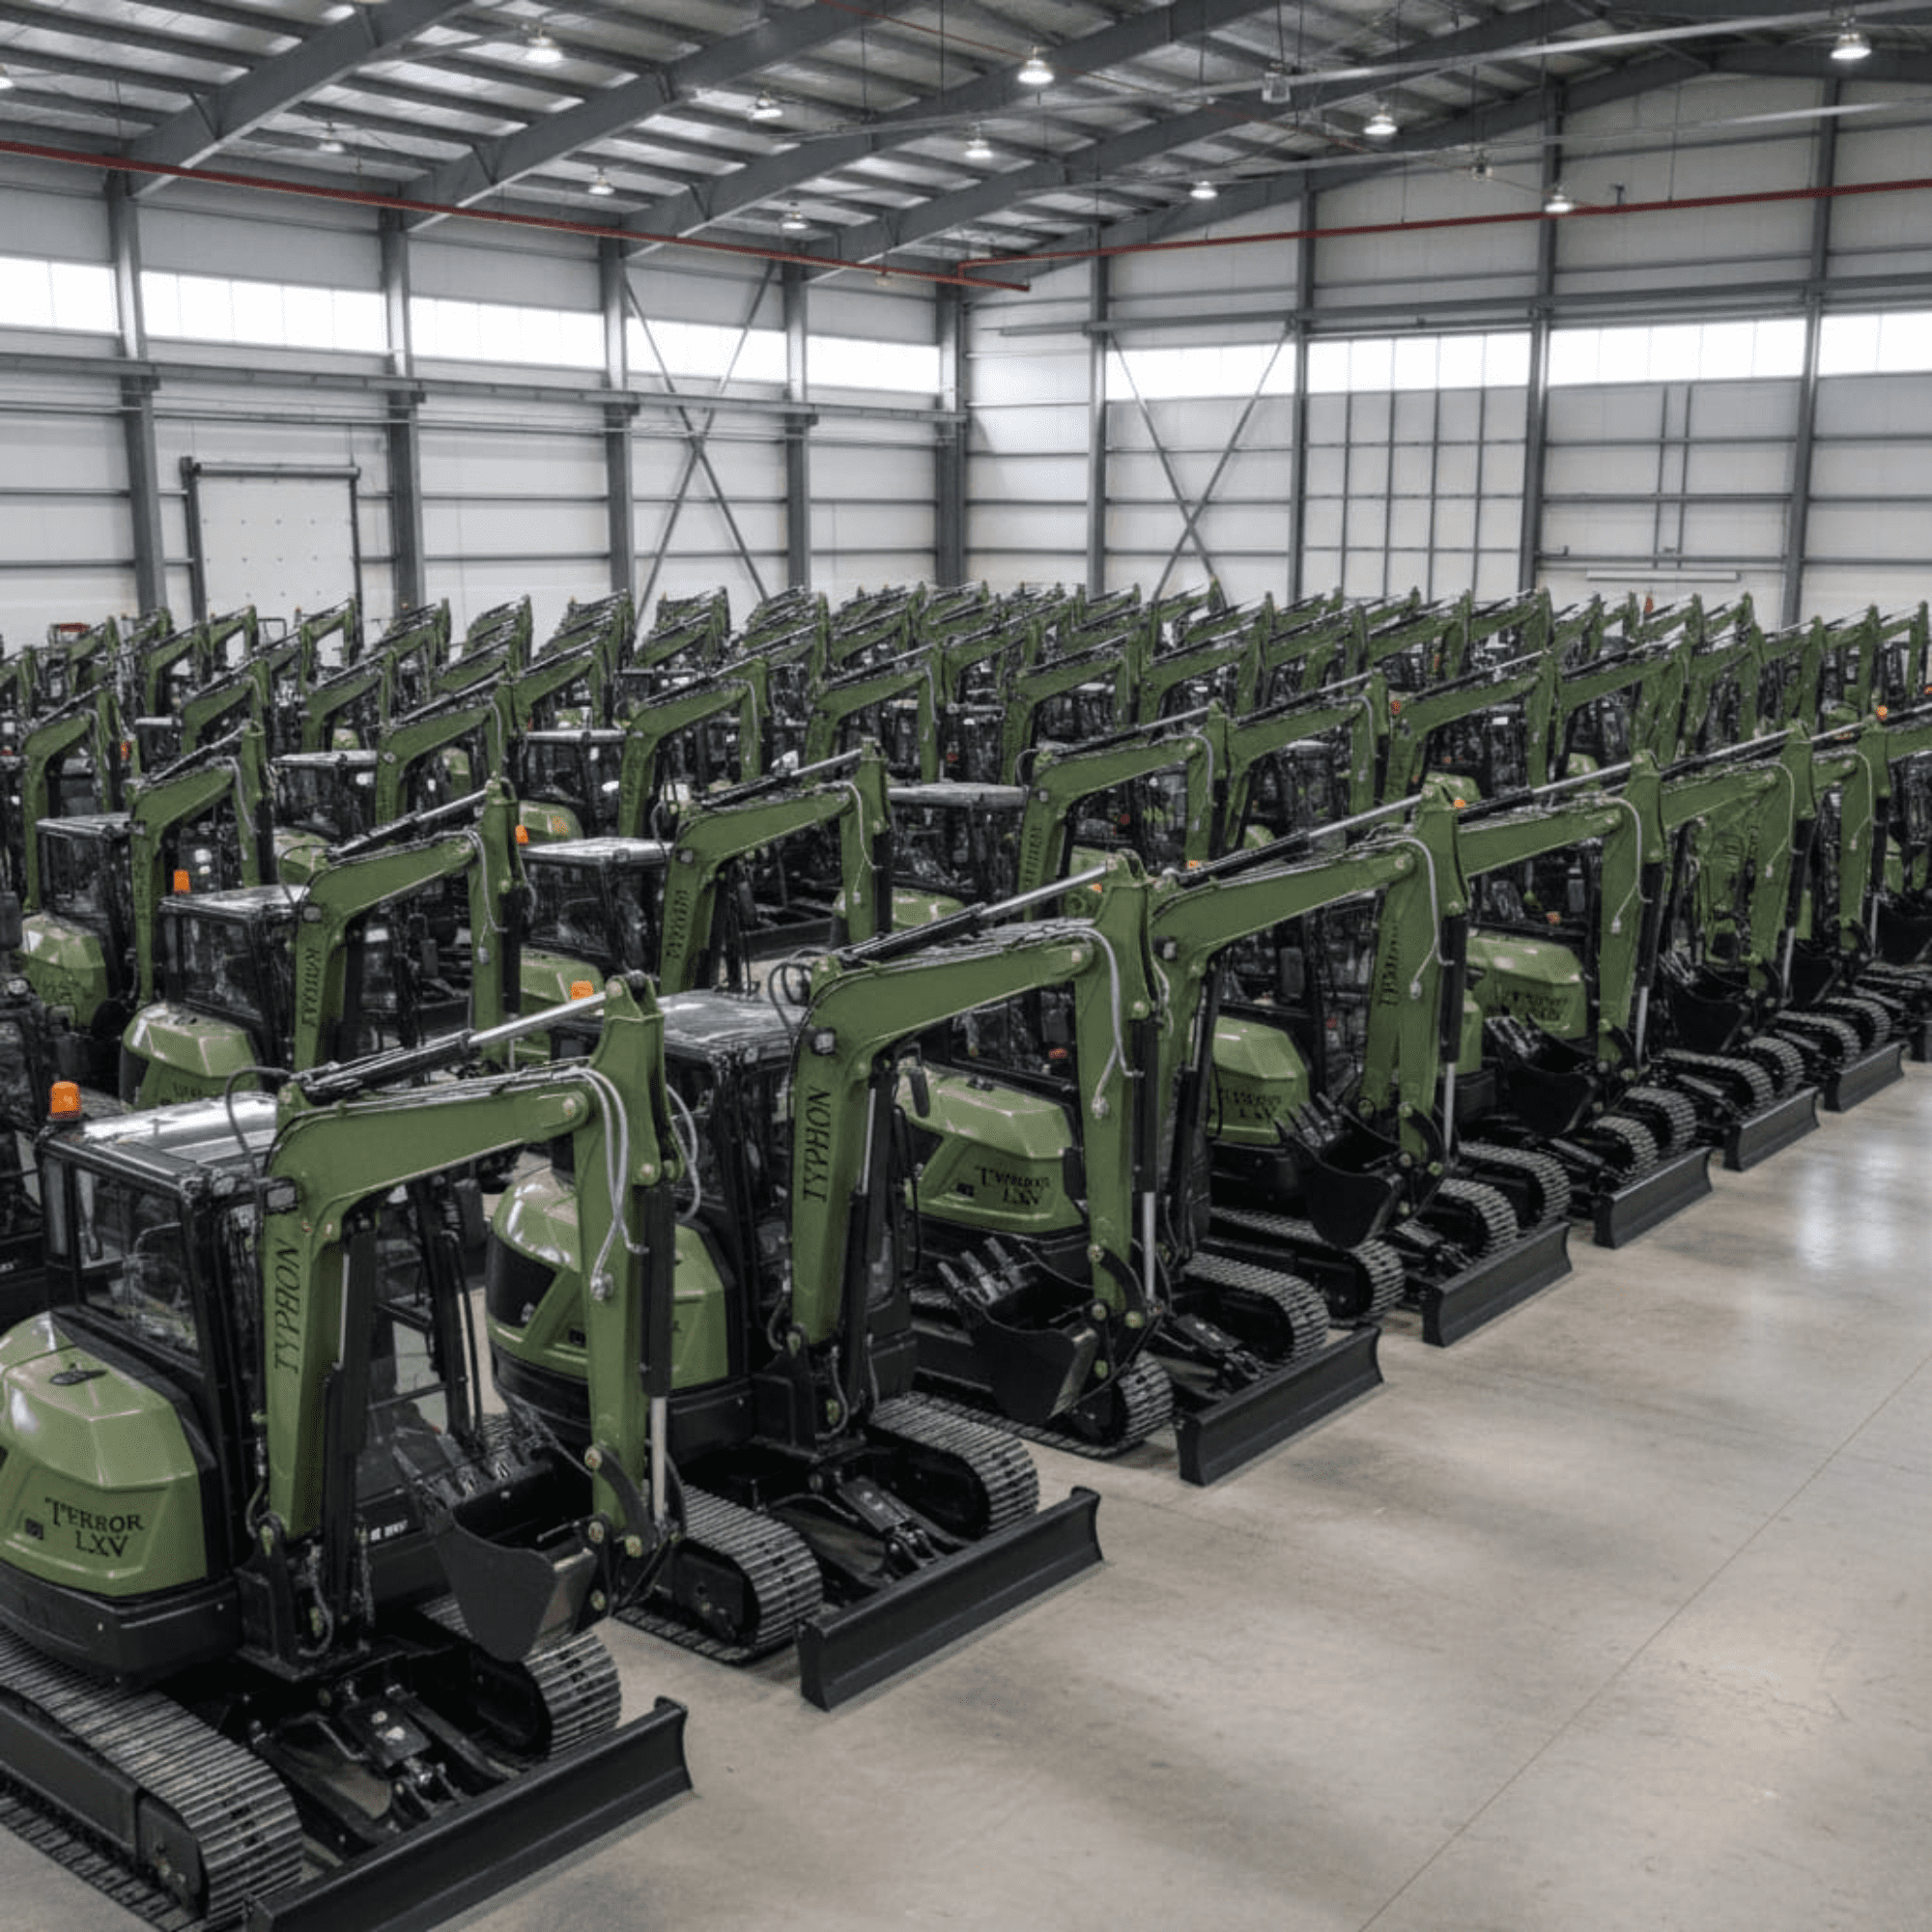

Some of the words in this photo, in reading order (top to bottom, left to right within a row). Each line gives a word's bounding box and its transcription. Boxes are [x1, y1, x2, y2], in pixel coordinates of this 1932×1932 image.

[803, 1084, 831, 1203] TYPHON
[44, 1496, 145, 1533] TERROR
[75, 1529, 128, 1558] LXV
